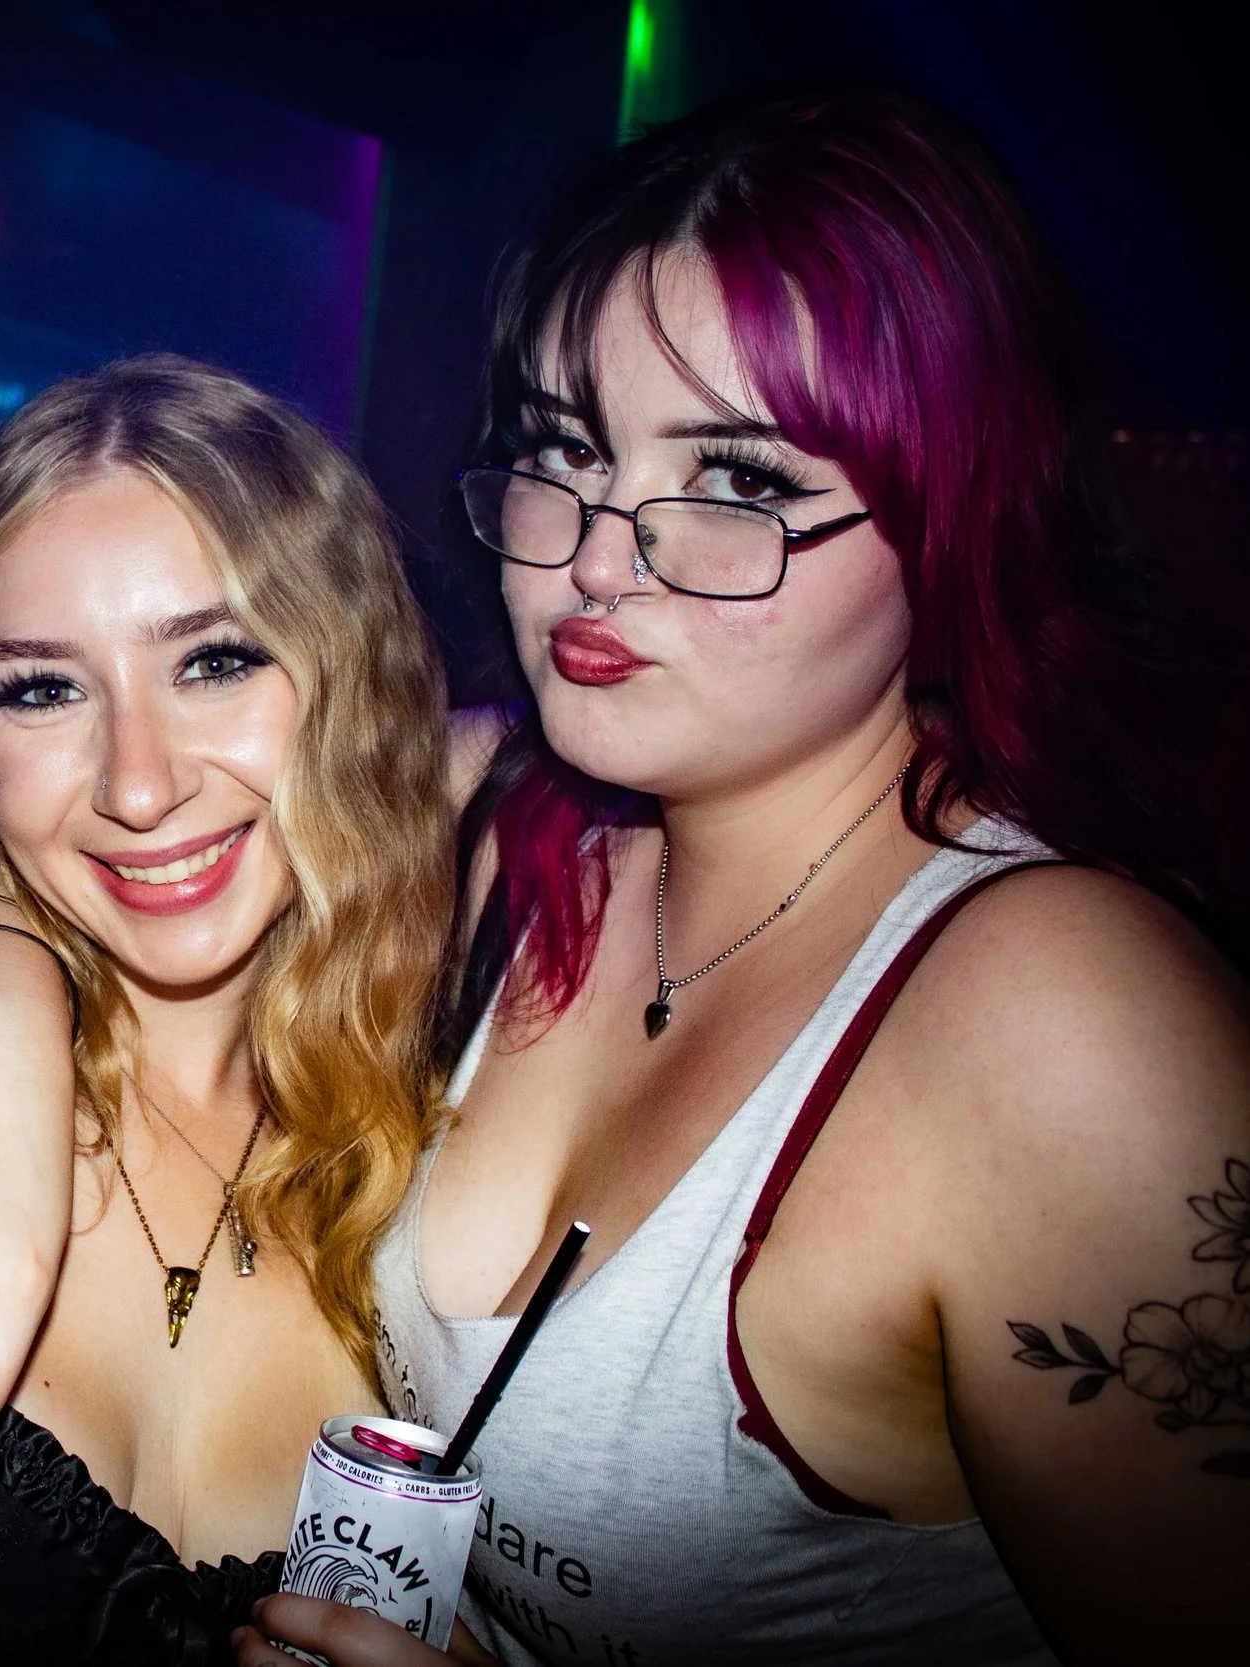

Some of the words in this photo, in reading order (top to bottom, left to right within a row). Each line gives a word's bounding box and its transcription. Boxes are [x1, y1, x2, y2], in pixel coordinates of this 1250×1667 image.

[335, 1459, 348, 1470] 100
[348, 1466, 383, 1485] CALORIES
[405, 1483, 430, 1494] CARBS
[438, 1486, 461, 1496] GLUTEN
[333, 1515, 430, 1592] CLAW
[474, 1496, 594, 1598] dare
